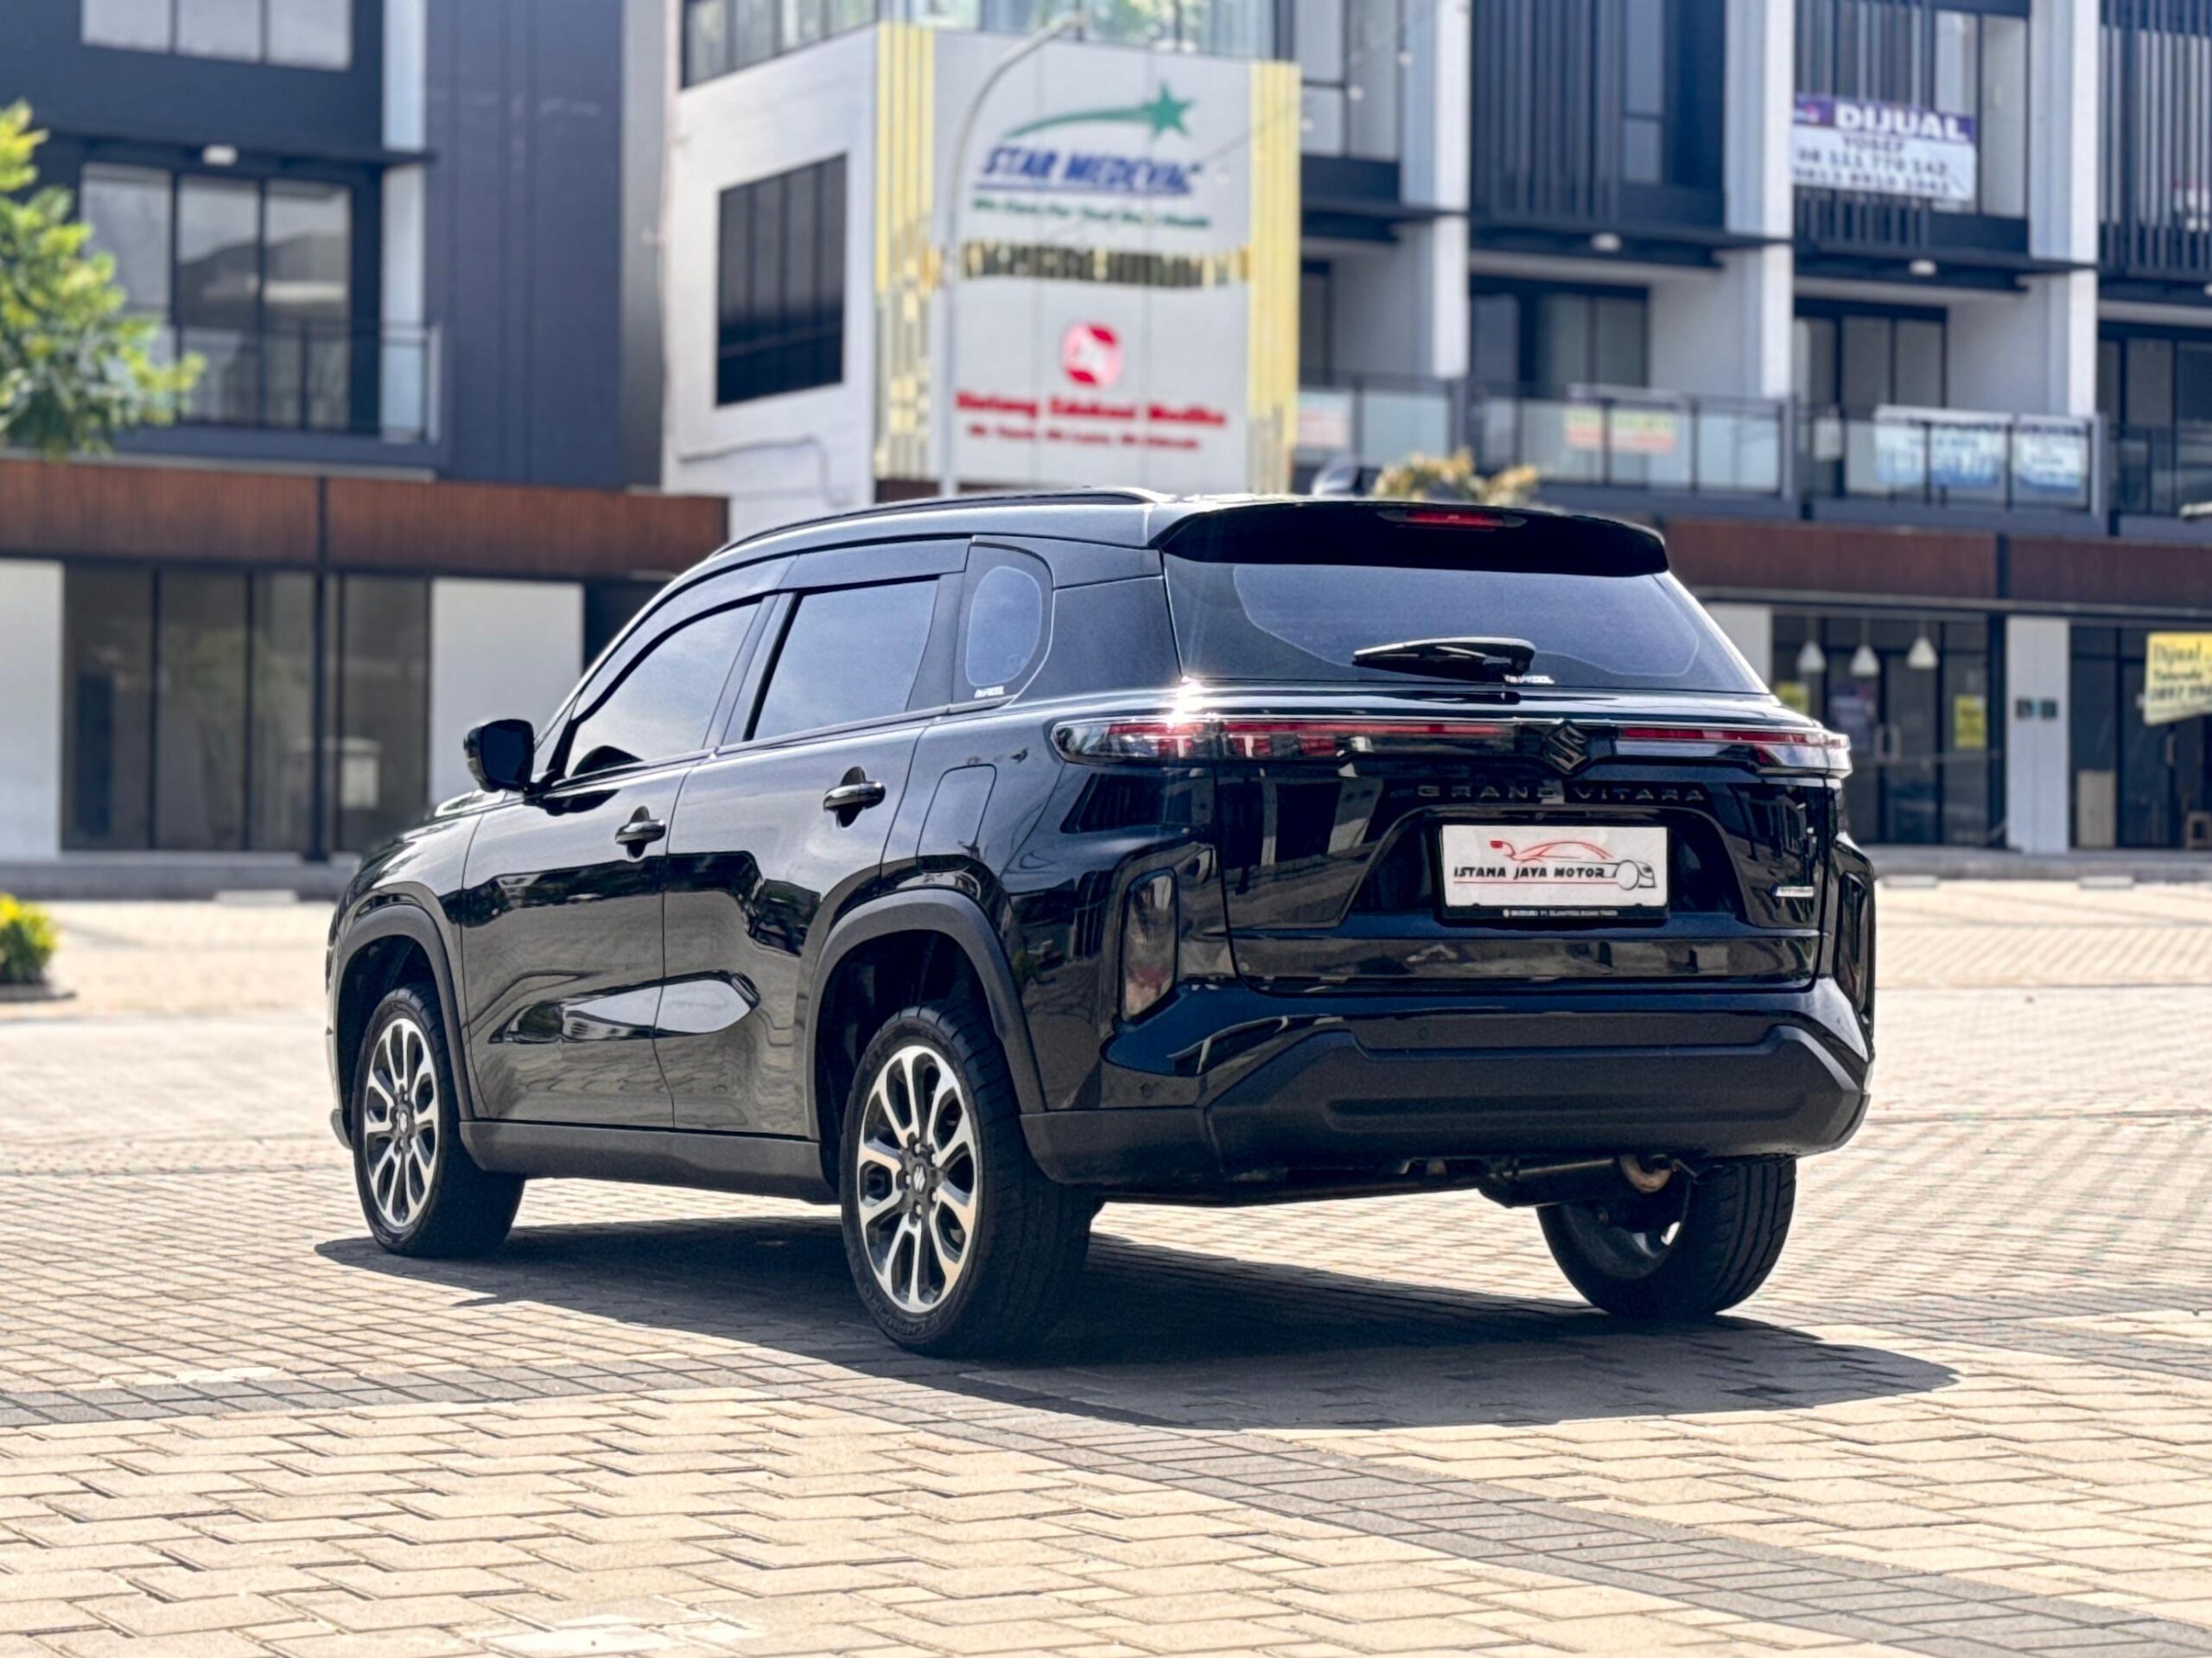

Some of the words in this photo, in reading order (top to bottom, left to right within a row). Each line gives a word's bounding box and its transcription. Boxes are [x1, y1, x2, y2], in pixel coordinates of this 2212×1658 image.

[1834, 102, 1969, 141] DIJUAL
[984, 147, 1057, 178] STAR
[1417, 785, 1557, 799] GRAND
[1574, 787, 1706, 802] VITARA
[1453, 867, 1506, 879] ISTANA
[1513, 867, 1547, 880] JAYA
[1554, 867, 1605, 880] MOTOR
